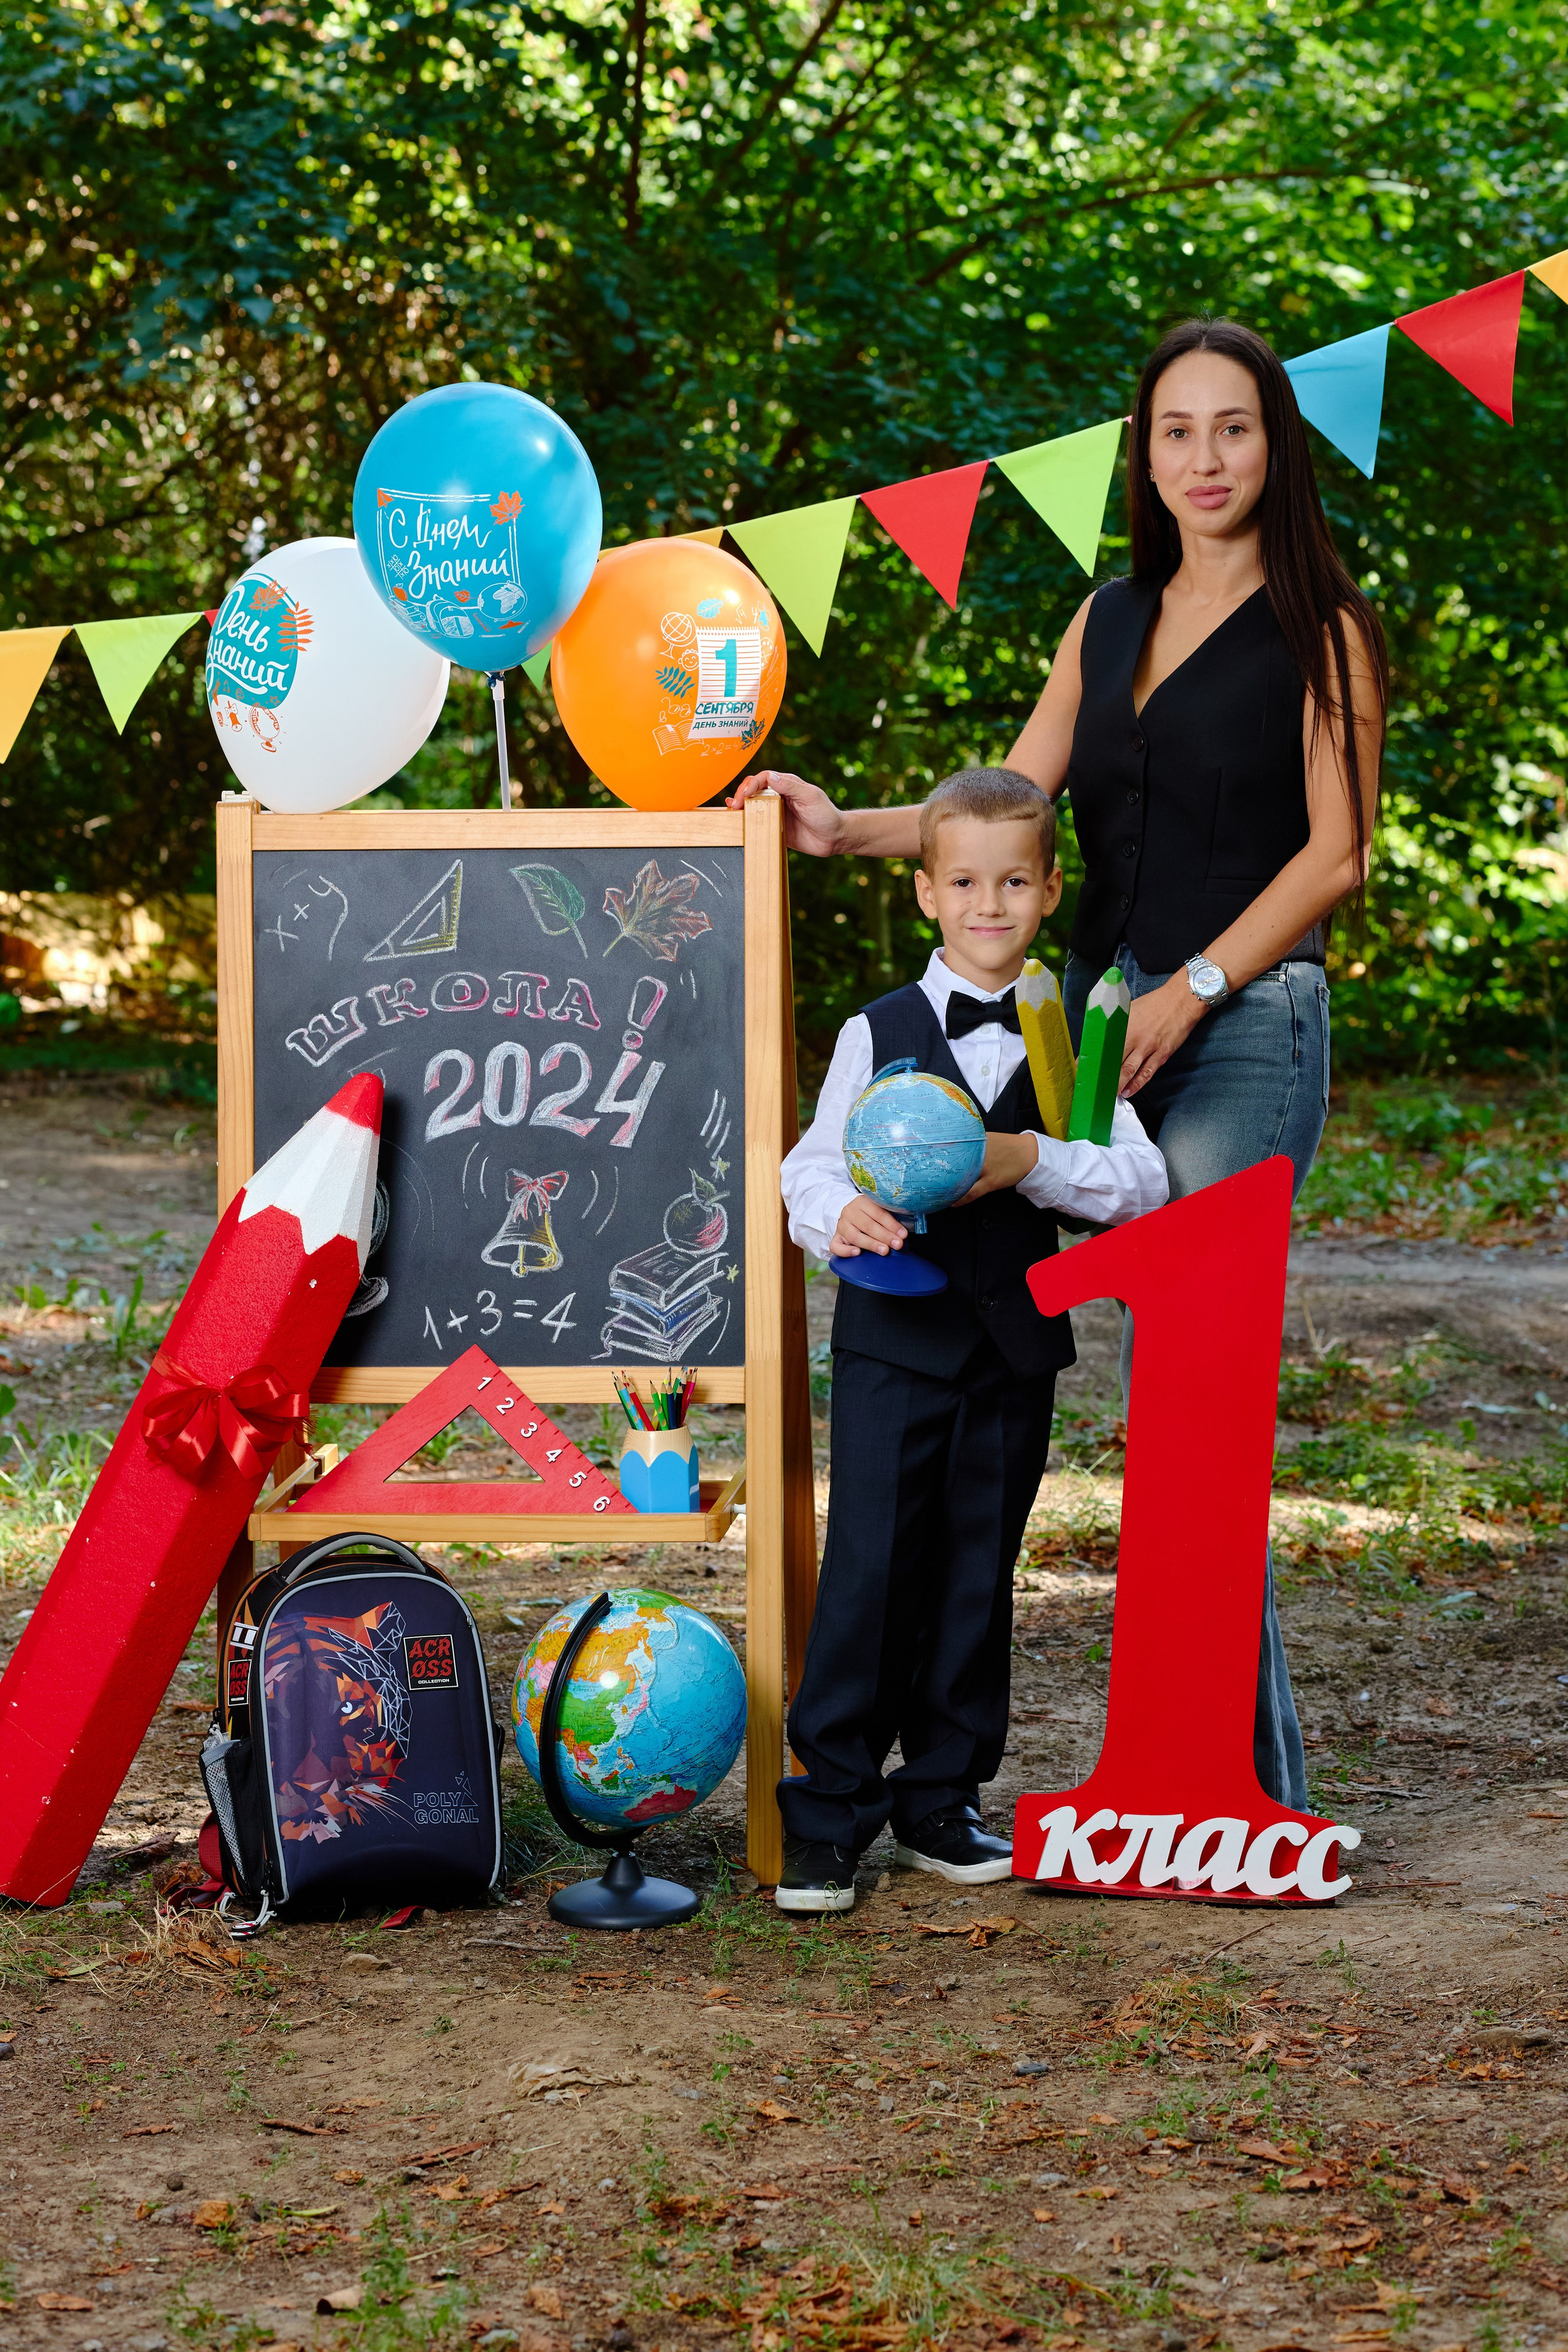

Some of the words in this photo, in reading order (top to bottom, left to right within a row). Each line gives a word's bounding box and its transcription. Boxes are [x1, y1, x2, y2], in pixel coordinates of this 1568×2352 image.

[389, 508, 408, 548] С
[413, 503, 492, 551] Днем
[407, 548, 510, 599] Знаний
[216, 584, 270, 652] День
[715, 639, 737, 698] 1
[693, 720, 717, 730] ДЕНЬ
[718, 719, 748, 728] ЗНАНИЙ
[695, 702, 754, 715] СЕНТЯБРЯ
[423, 1040, 666, 1148] 2024
[477, 1377, 492, 1392] 1
[496, 1397, 514, 1415] 2
[521, 1422, 538, 1438] 3
[546, 1449, 562, 1463] 4
[569, 1471, 587, 1487] 5
[593, 1496, 611, 1512] 6
[413, 1792, 461, 1807] POLY
[414, 1809, 479, 1825] GONAL
